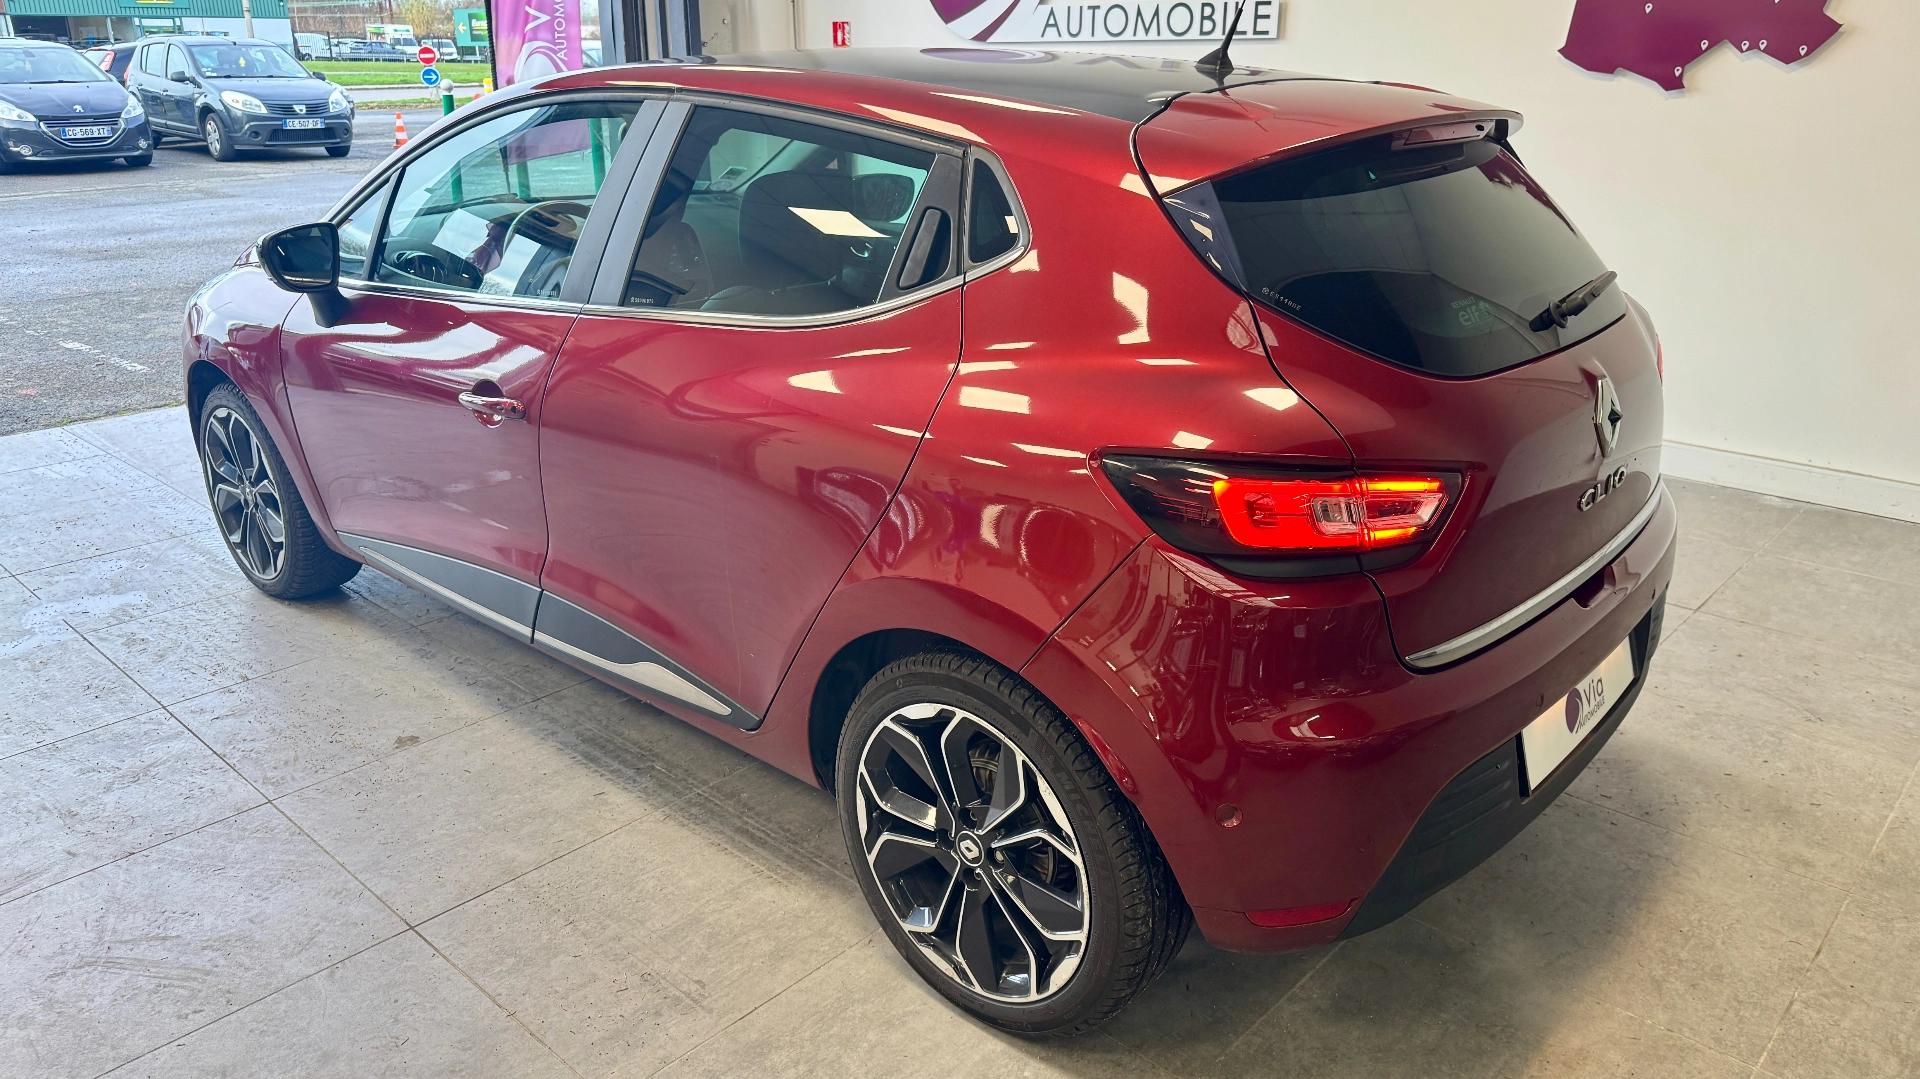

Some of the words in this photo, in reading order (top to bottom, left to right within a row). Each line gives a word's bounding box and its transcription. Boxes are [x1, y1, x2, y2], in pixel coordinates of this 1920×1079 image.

[553, 0, 568, 60] AUTOM
[1041, 1, 1272, 38] AUTOMOBILE
[1577, 465, 1627, 511] CLIO
[1583, 677, 1604, 708] Via
